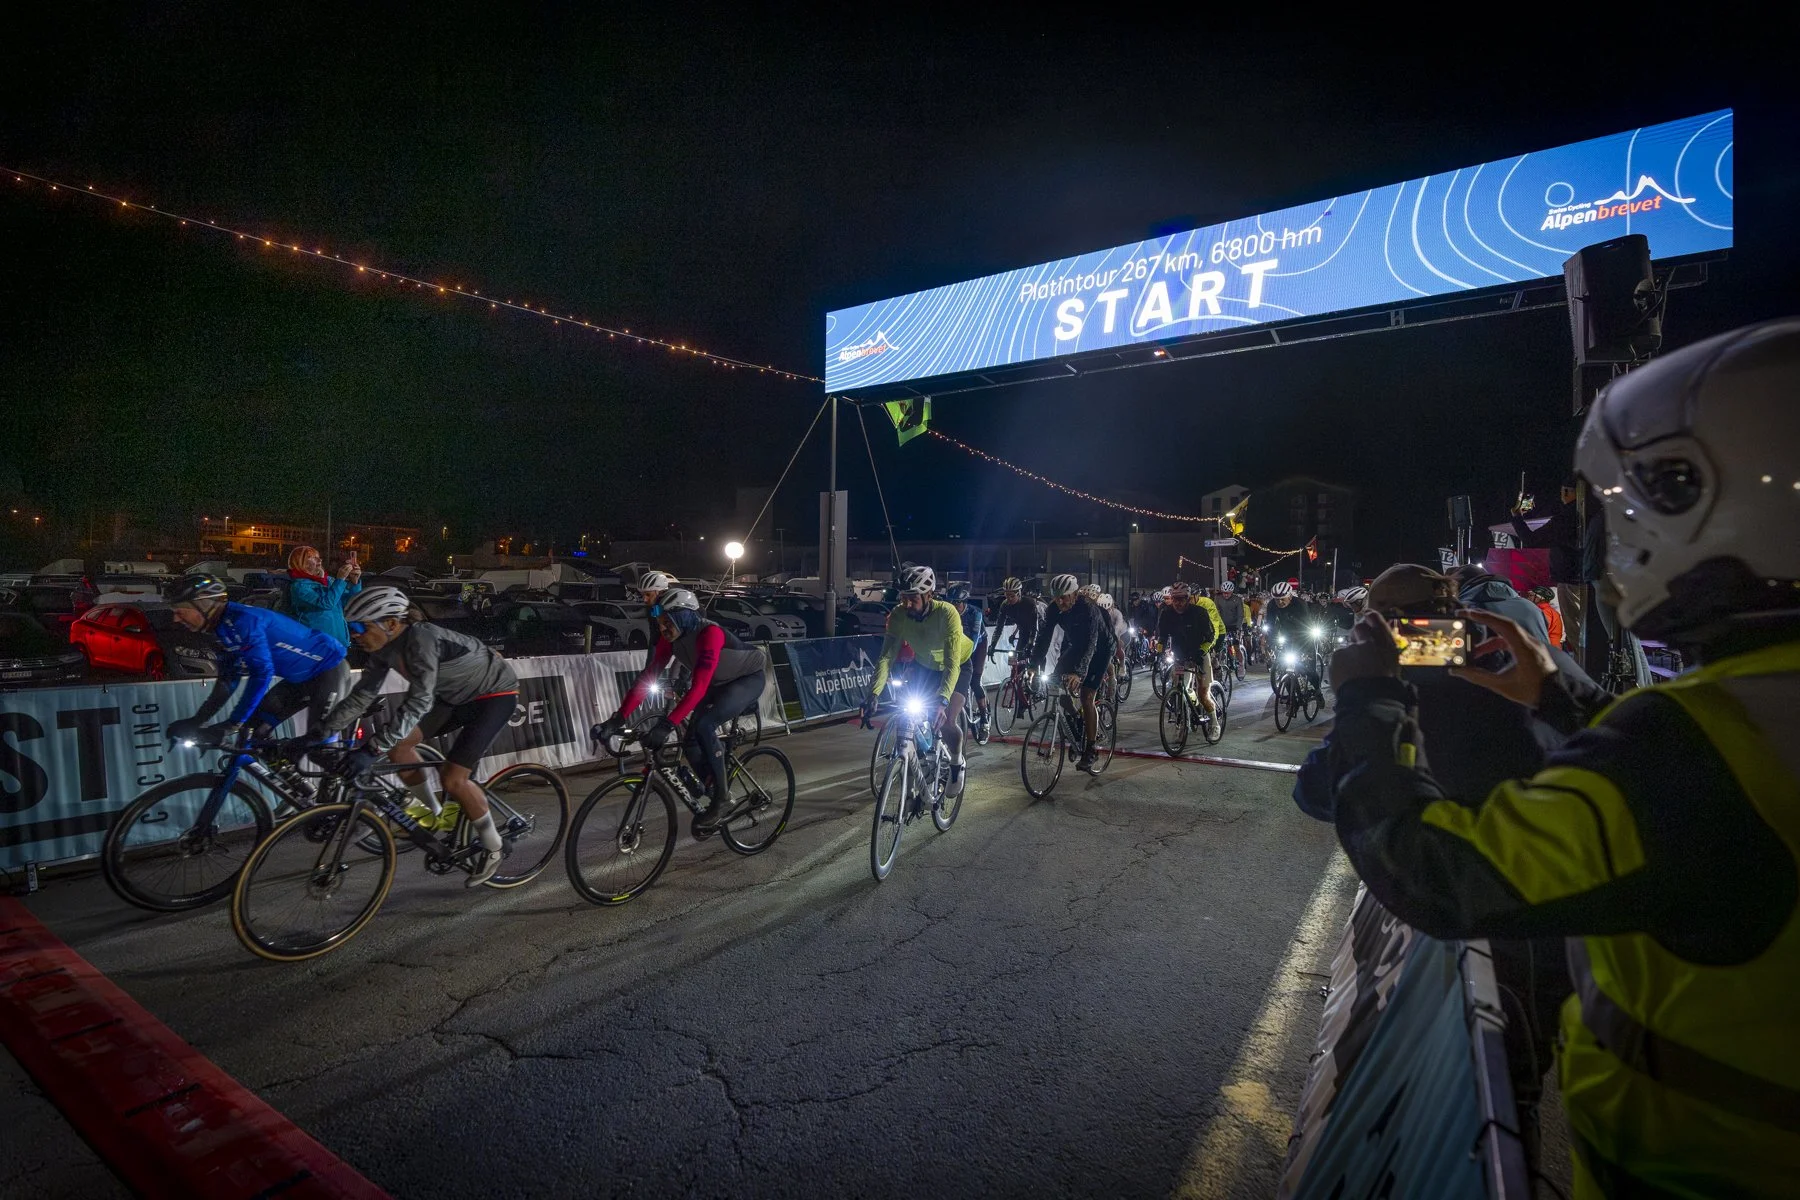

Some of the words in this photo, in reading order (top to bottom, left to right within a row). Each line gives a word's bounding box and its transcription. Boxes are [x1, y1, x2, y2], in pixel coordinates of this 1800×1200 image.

[1540, 195, 1662, 231] Alpenbrevet
[1020, 268, 1118, 304] Platintour
[1121, 256, 1161, 283] 267
[1164, 250, 1204, 275] km,
[1282, 226, 1323, 251] hm
[1054, 258, 1278, 342] START
[838, 343, 887, 362] Alpenbrevet
[815, 673, 872, 697] Alpenbrev
[131, 702, 169, 825] CCLING
